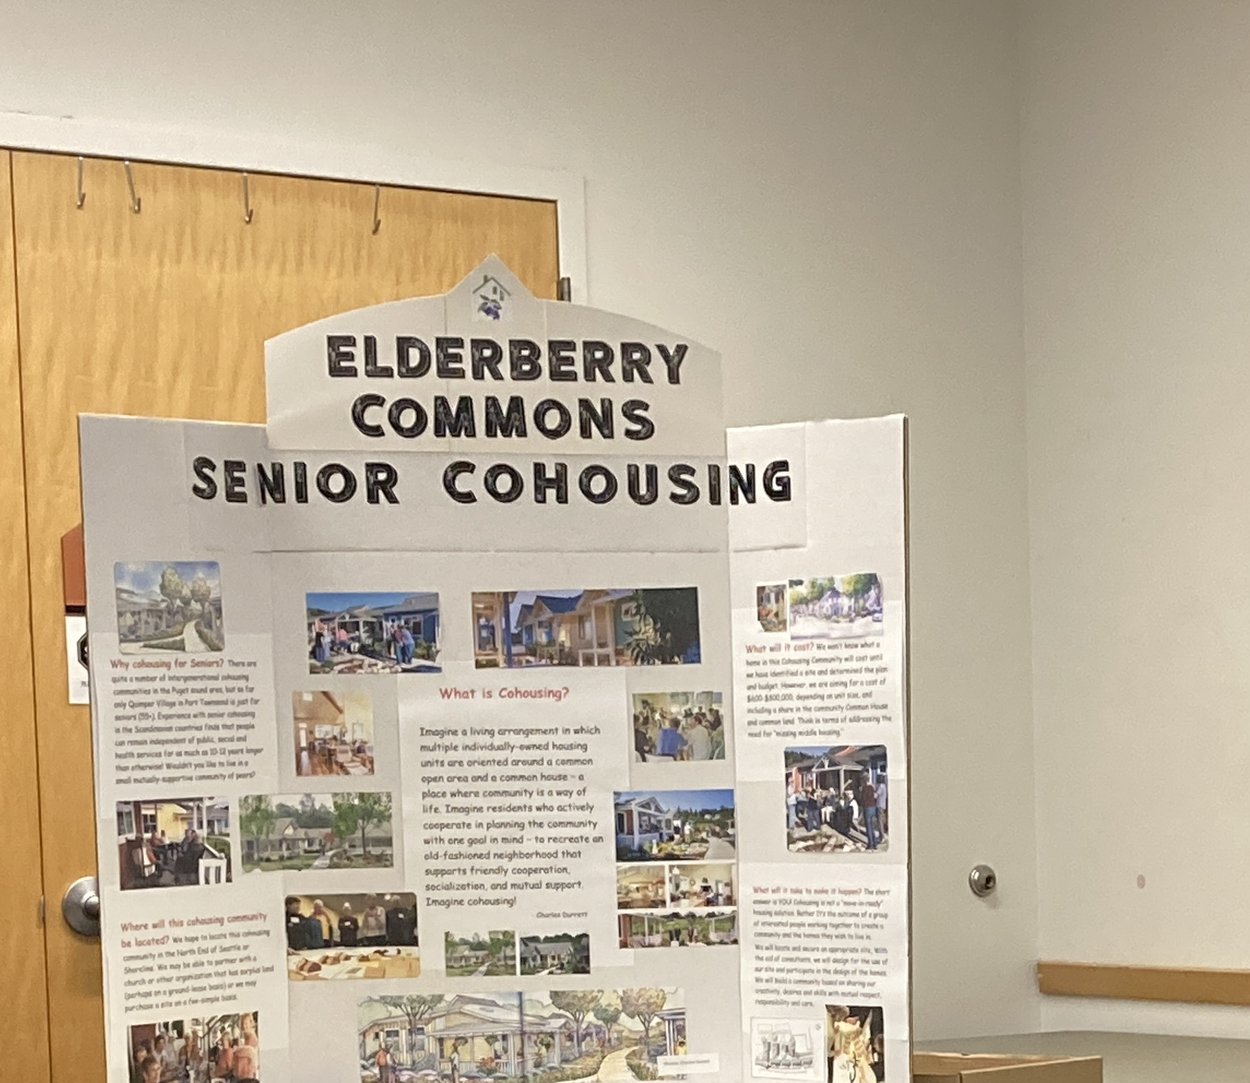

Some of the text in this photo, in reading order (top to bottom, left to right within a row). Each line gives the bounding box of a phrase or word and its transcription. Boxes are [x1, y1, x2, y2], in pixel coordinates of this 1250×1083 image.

[327, 333, 689, 385] ELDERBERRY
[352, 393, 655, 442] COMMONS
[192, 456, 792, 507] SENIOR COHOUSING
[745, 645, 766, 654] What
[769, 644, 781, 652] will
[784, 643, 791, 651] it
[794, 642, 814, 651] cost?
[110, 659, 129, 671] Why
[132, 659, 172, 671] cohousing
[174, 658, 187, 668] for
[190, 658, 224, 668] Seniors?
[439, 687, 569, 701] What is Cohousing?
[419, 726, 601, 739] Imagine a living arrangement in which
[420, 742, 588, 753] multiple individually-owned housing
[421, 758, 445, 768] units
[447, 759, 464, 768] are
[466, 758, 508, 767] oriented
[511, 757, 544, 767] around
[555, 758, 593, 766] common
[421, 775, 444, 785] open
[446, 775, 469, 783] area
[471, 773, 488, 782] and
[499, 774, 538, 782] common
[540, 773, 568, 781] house
[422, 789, 447, 801] place
[449, 789, 480, 798] where
[482, 789, 533, 799] community
[536, 789, 545, 797] is
[555, 789, 574, 799] way
[576, 787, 587, 797] of
[422, 803, 594, 816] life. Imagine residents who actively
[423, 819, 597, 832] cooperate in planning the community
[423, 836, 445, 845] with
[448, 837, 465, 845] one
[467, 835, 487, 847] goal
[489, 836, 498, 845] in
[501, 835, 524, 844] mind
[534, 835, 545, 844] to
[547, 835, 590, 844] recreate
[592, 835, 604, 843] an
[424, 850, 581, 861] old-fashioned neighborhood that
[425, 866, 570, 878] supports friendly cooperation,
[425, 882, 488, 892] socialization,
[490, 881, 507, 890] and
[510, 881, 542, 890] mutual
[753, 886, 769, 894] What
[426, 896, 517, 908] Imagine cohousing!
[536, 911, 560, 919] Charles
[121, 912, 267, 933] Where will this cohousing community
[121, 940, 132, 948] be
[135, 935, 169, 947] located?
[172, 936, 183, 944] We
[184, 935, 199, 944] hope
[209, 932, 227, 940] locate
[242, 929, 270, 938] cohousing
[123, 952, 156, 962] community
[165, 950, 175, 958] the
[177, 948, 196, 957] North
[198, 947, 209, 955] End
[210, 946, 218, 954] of
[219, 944, 241, 953] Seattle
[157, 963, 167, 971] We
[169, 963, 181, 972] may
[183, 961, 191, 969] be
[192, 960, 205, 968] able
[215, 957, 237, 967] partner
[239, 955, 251, 963] with
[124, 978, 146, 987] church
[156, 975, 173, 984] other
[175, 972, 212, 983] organization
[214, 970, 227, 978] that
[245, 980, 257, 988] may
[124, 1003, 153, 1013] purchase
[161, 999, 173, 1009] site
